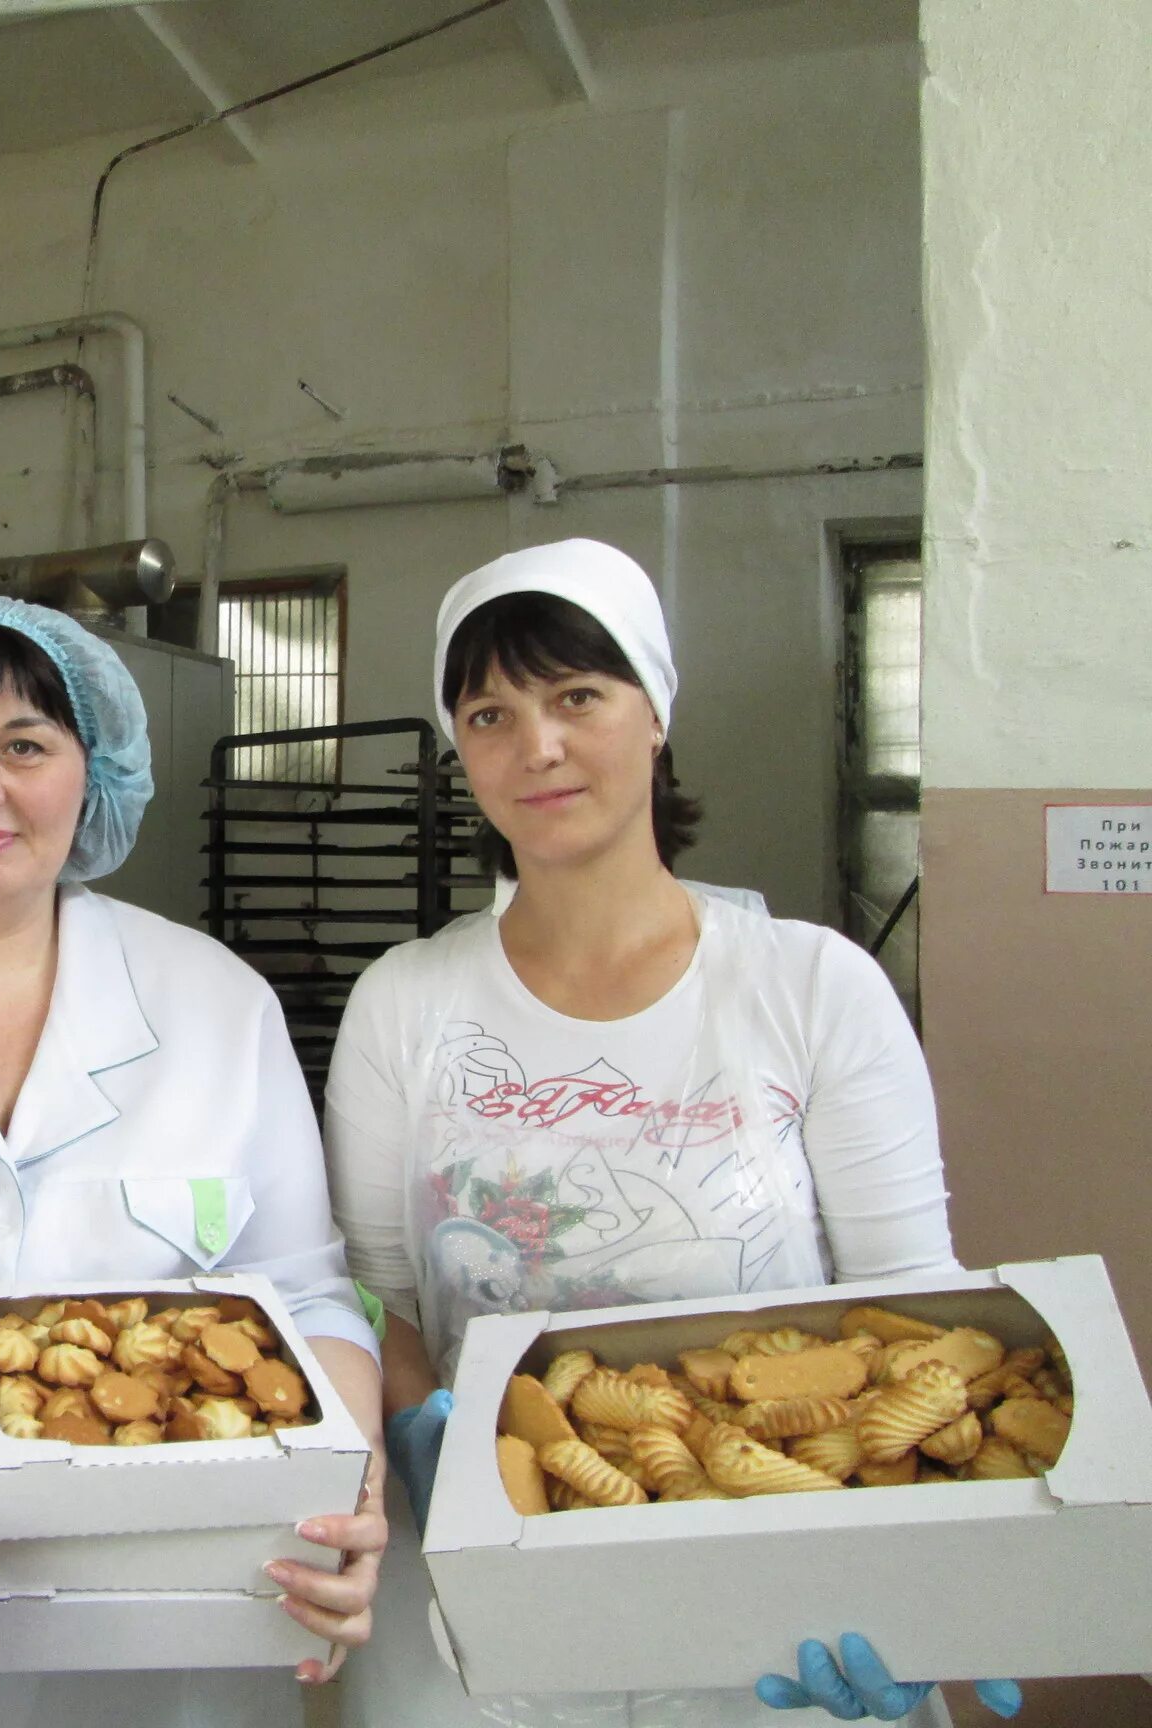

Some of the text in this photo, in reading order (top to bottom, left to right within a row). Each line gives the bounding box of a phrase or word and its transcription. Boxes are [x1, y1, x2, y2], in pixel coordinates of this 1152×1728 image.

[1101, 820, 1141, 833] При
[1080, 839, 1150, 852] Пожар
[1077, 858, 1152, 869] Звонит
[1102, 880, 1140, 891] 101
